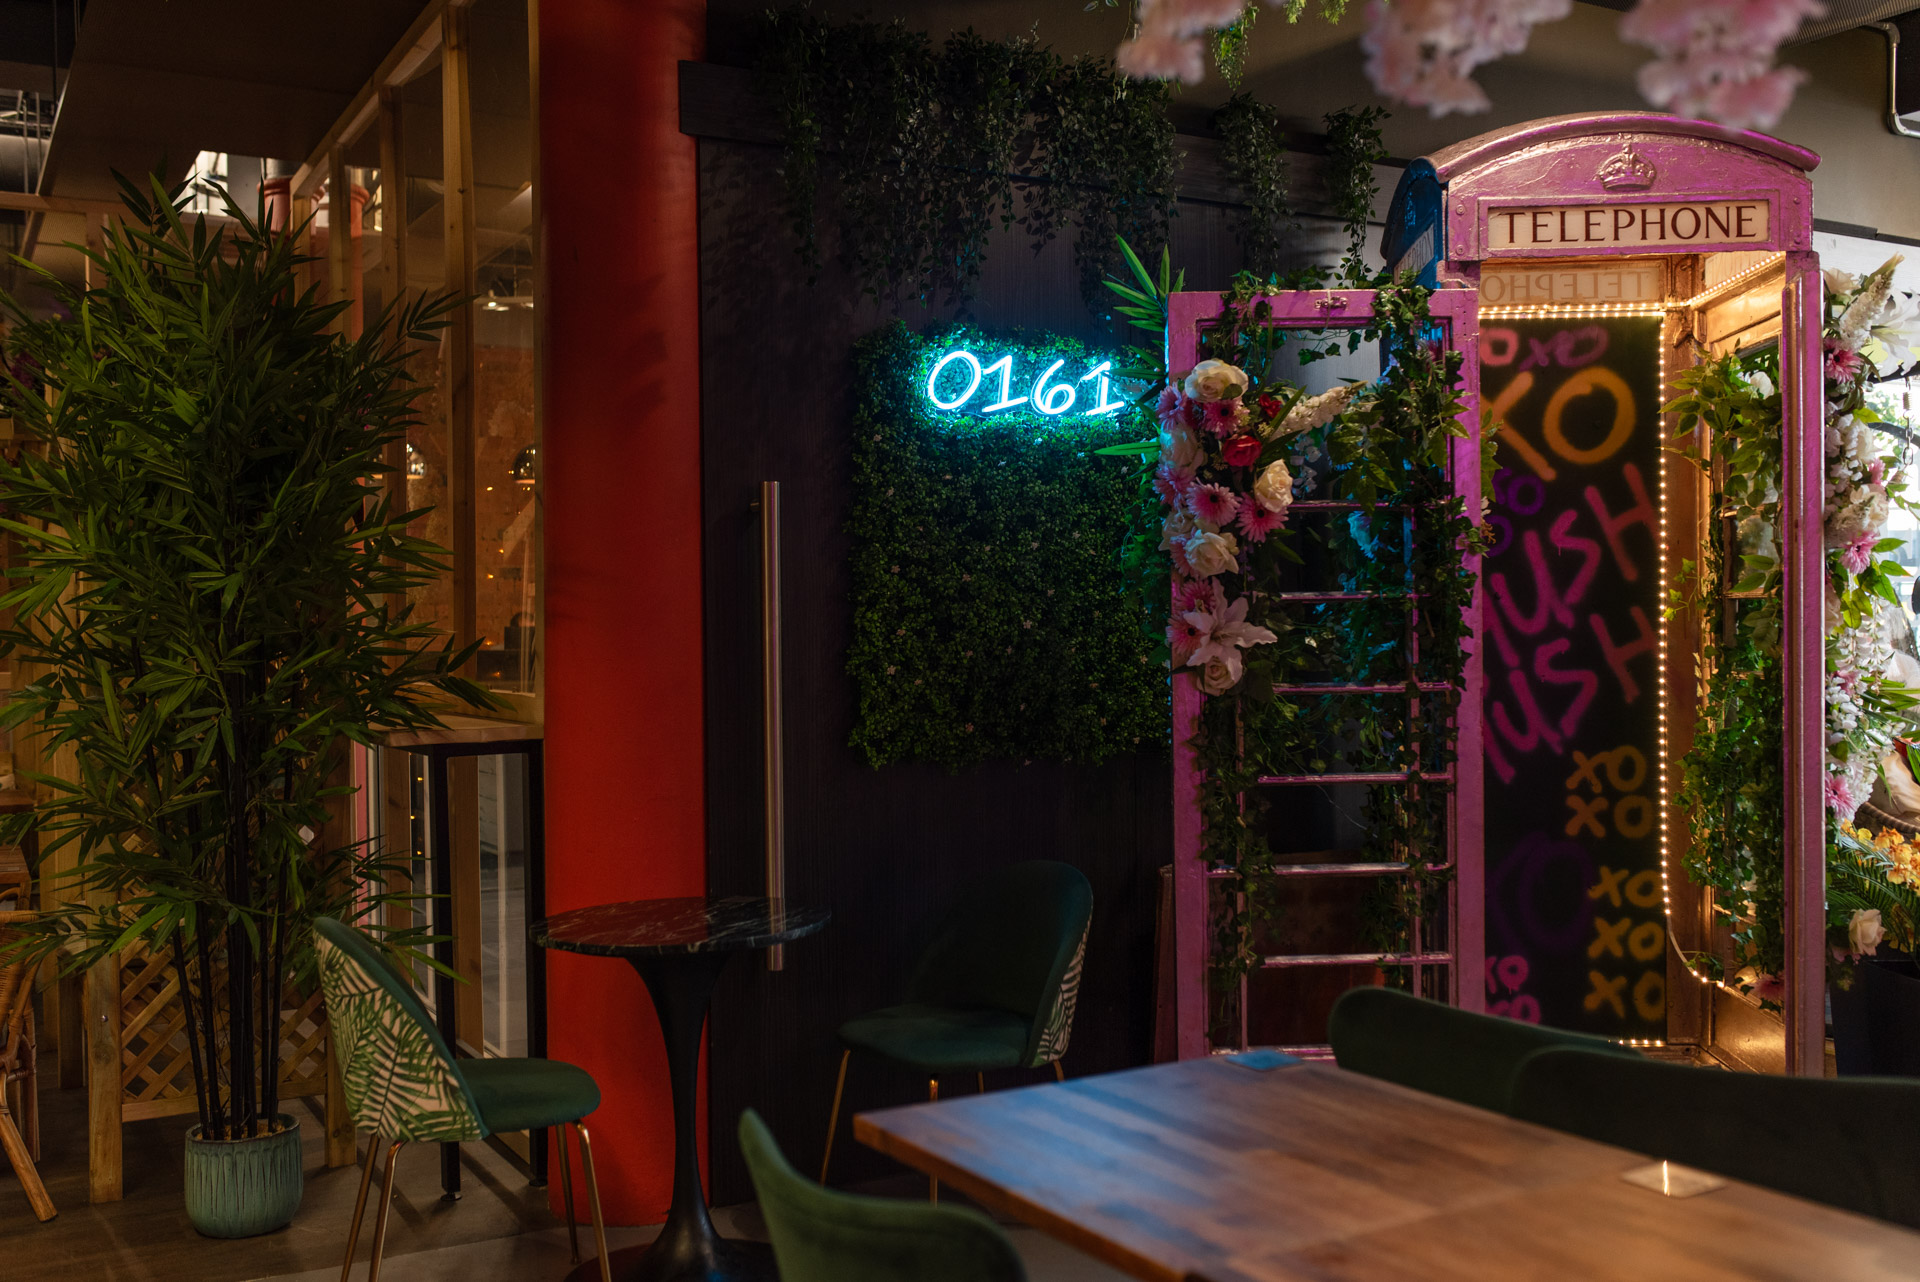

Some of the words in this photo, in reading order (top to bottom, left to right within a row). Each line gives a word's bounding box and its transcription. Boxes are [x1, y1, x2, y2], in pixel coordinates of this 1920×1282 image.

[1498, 204, 1757, 244] TELEPHONE
[927, 350, 1125, 415] 0161
[1567, 745, 1647, 794] XO
[1565, 794, 1655, 839] XO
[1588, 865, 1665, 908] XO
[1588, 916, 1666, 962] XO
[1583, 969, 1666, 1022] XO
